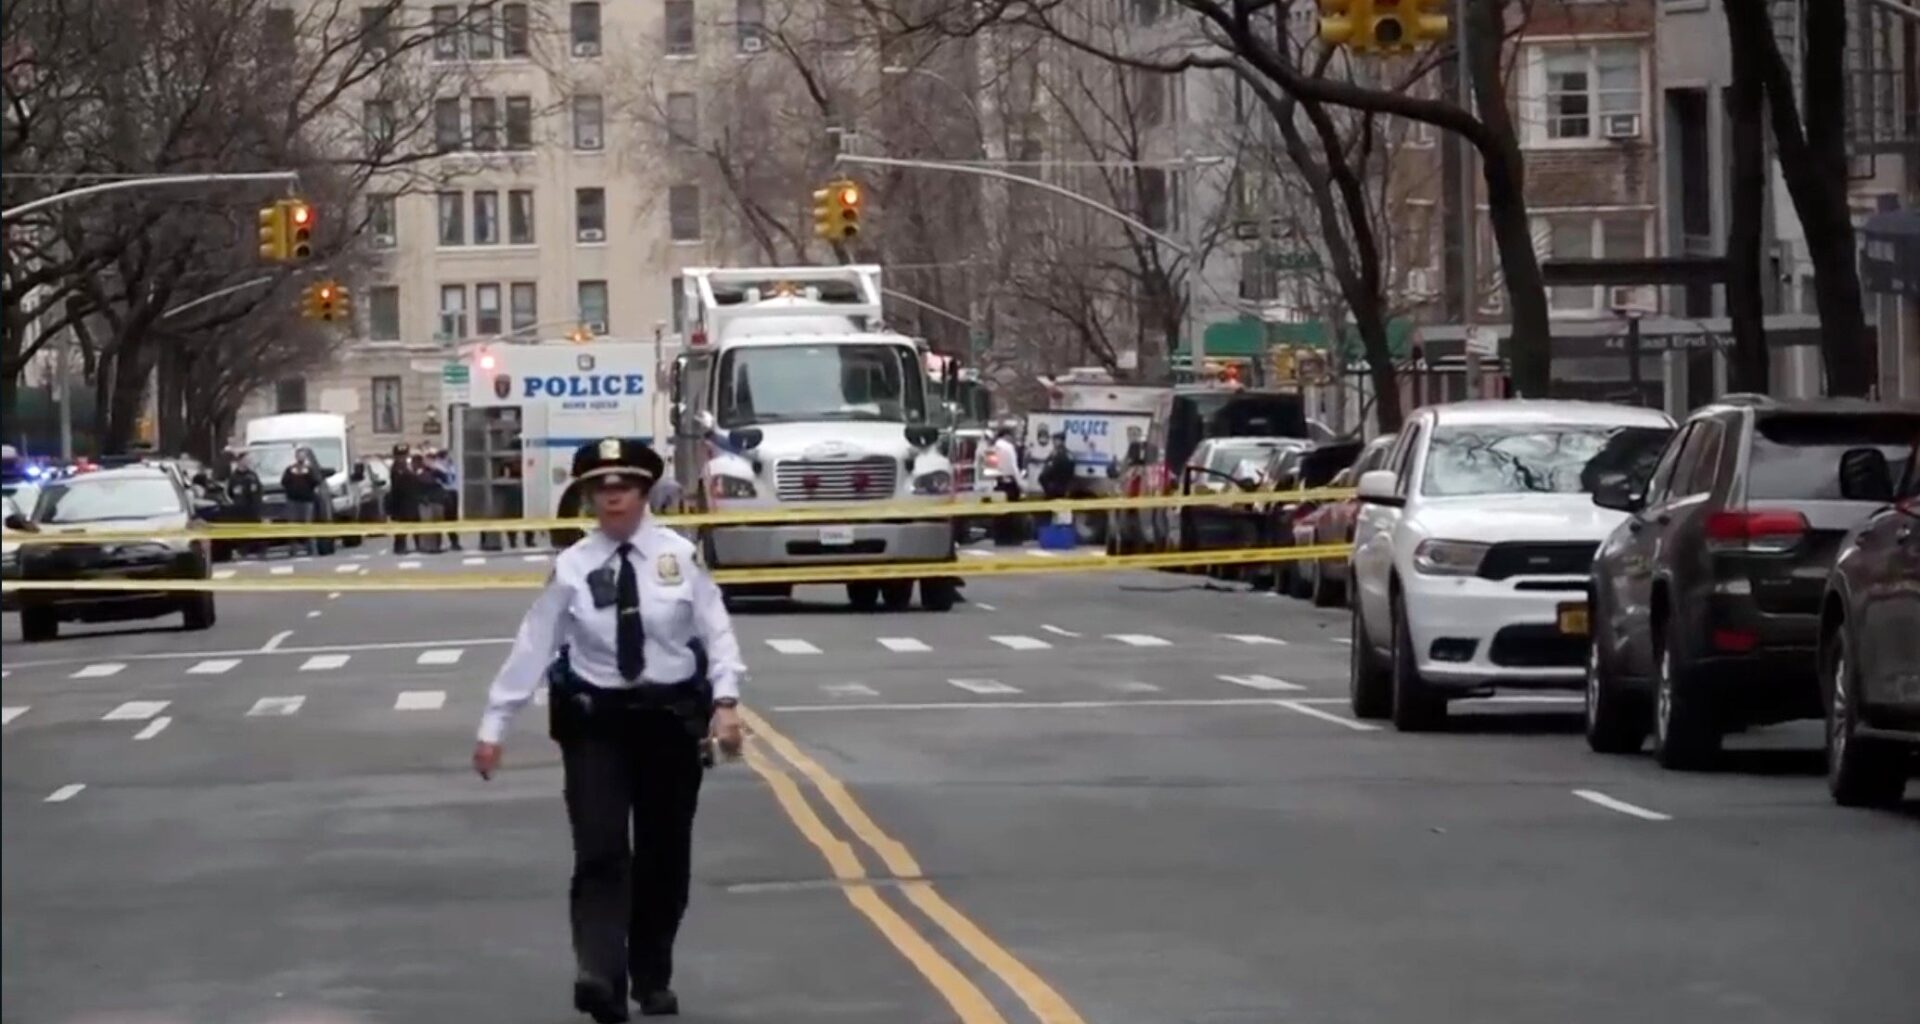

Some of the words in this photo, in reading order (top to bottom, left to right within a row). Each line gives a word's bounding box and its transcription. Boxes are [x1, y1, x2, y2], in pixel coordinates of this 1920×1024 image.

[1672, 334, 1707, 348] End
[523, 374, 644, 398] POLICE
[1064, 419, 1109, 436] POLICE
